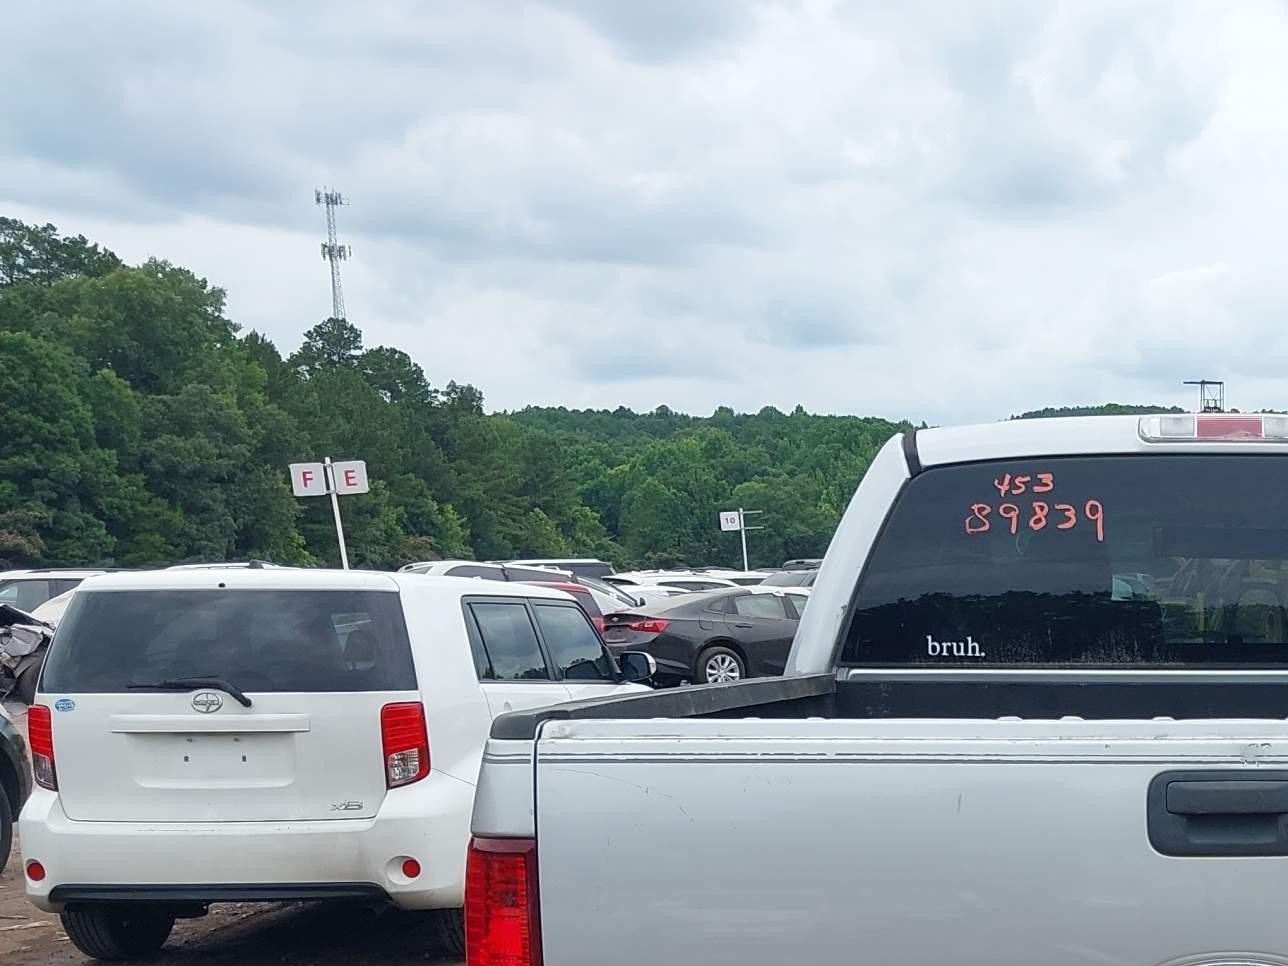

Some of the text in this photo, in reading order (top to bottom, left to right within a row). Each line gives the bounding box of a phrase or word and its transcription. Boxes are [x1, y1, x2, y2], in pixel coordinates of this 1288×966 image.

[302, 471, 314, 489] F
[344, 469, 358, 487] E
[994, 472, 1055, 498] 453
[725, 516, 736, 525] 10
[964, 499, 1105, 542] 89839
[926, 634, 986, 657] bruh.
